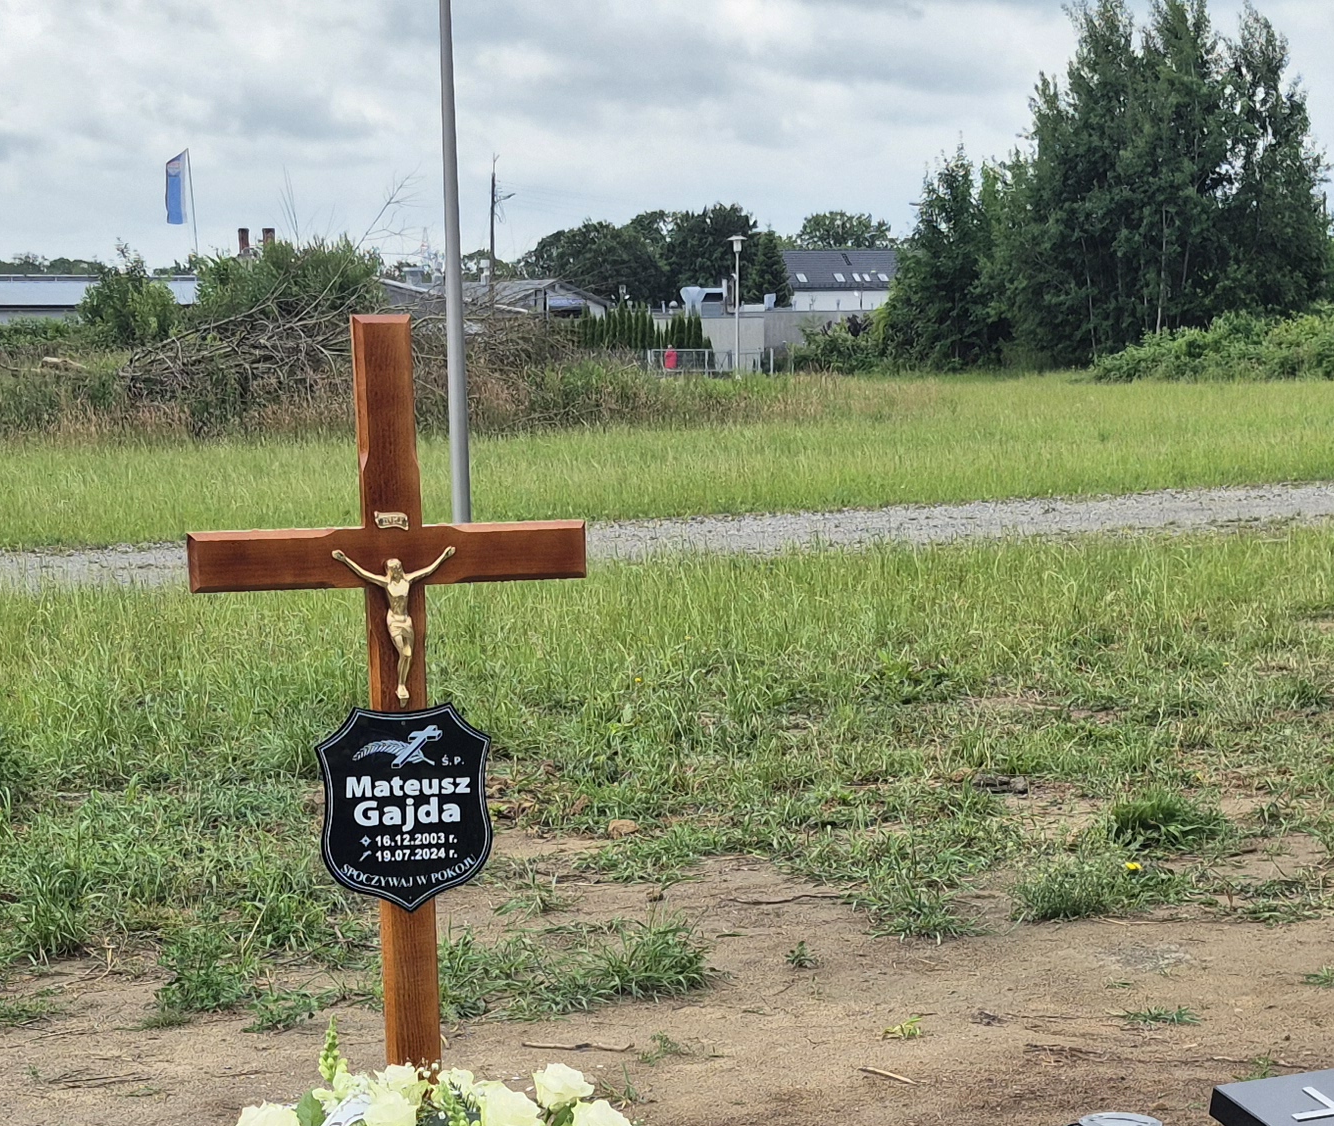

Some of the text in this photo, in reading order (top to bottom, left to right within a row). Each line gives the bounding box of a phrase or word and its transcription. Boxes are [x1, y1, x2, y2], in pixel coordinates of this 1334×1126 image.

[345, 775, 471, 799] Mateusz
[353, 796, 461, 832] Gajda
[375, 833, 458, 847] 16.12.2003 r.
[375, 848, 458, 862] 19.07.2024 r.
[340, 853, 477, 888] SPOCZYWAJ W POKOJU
